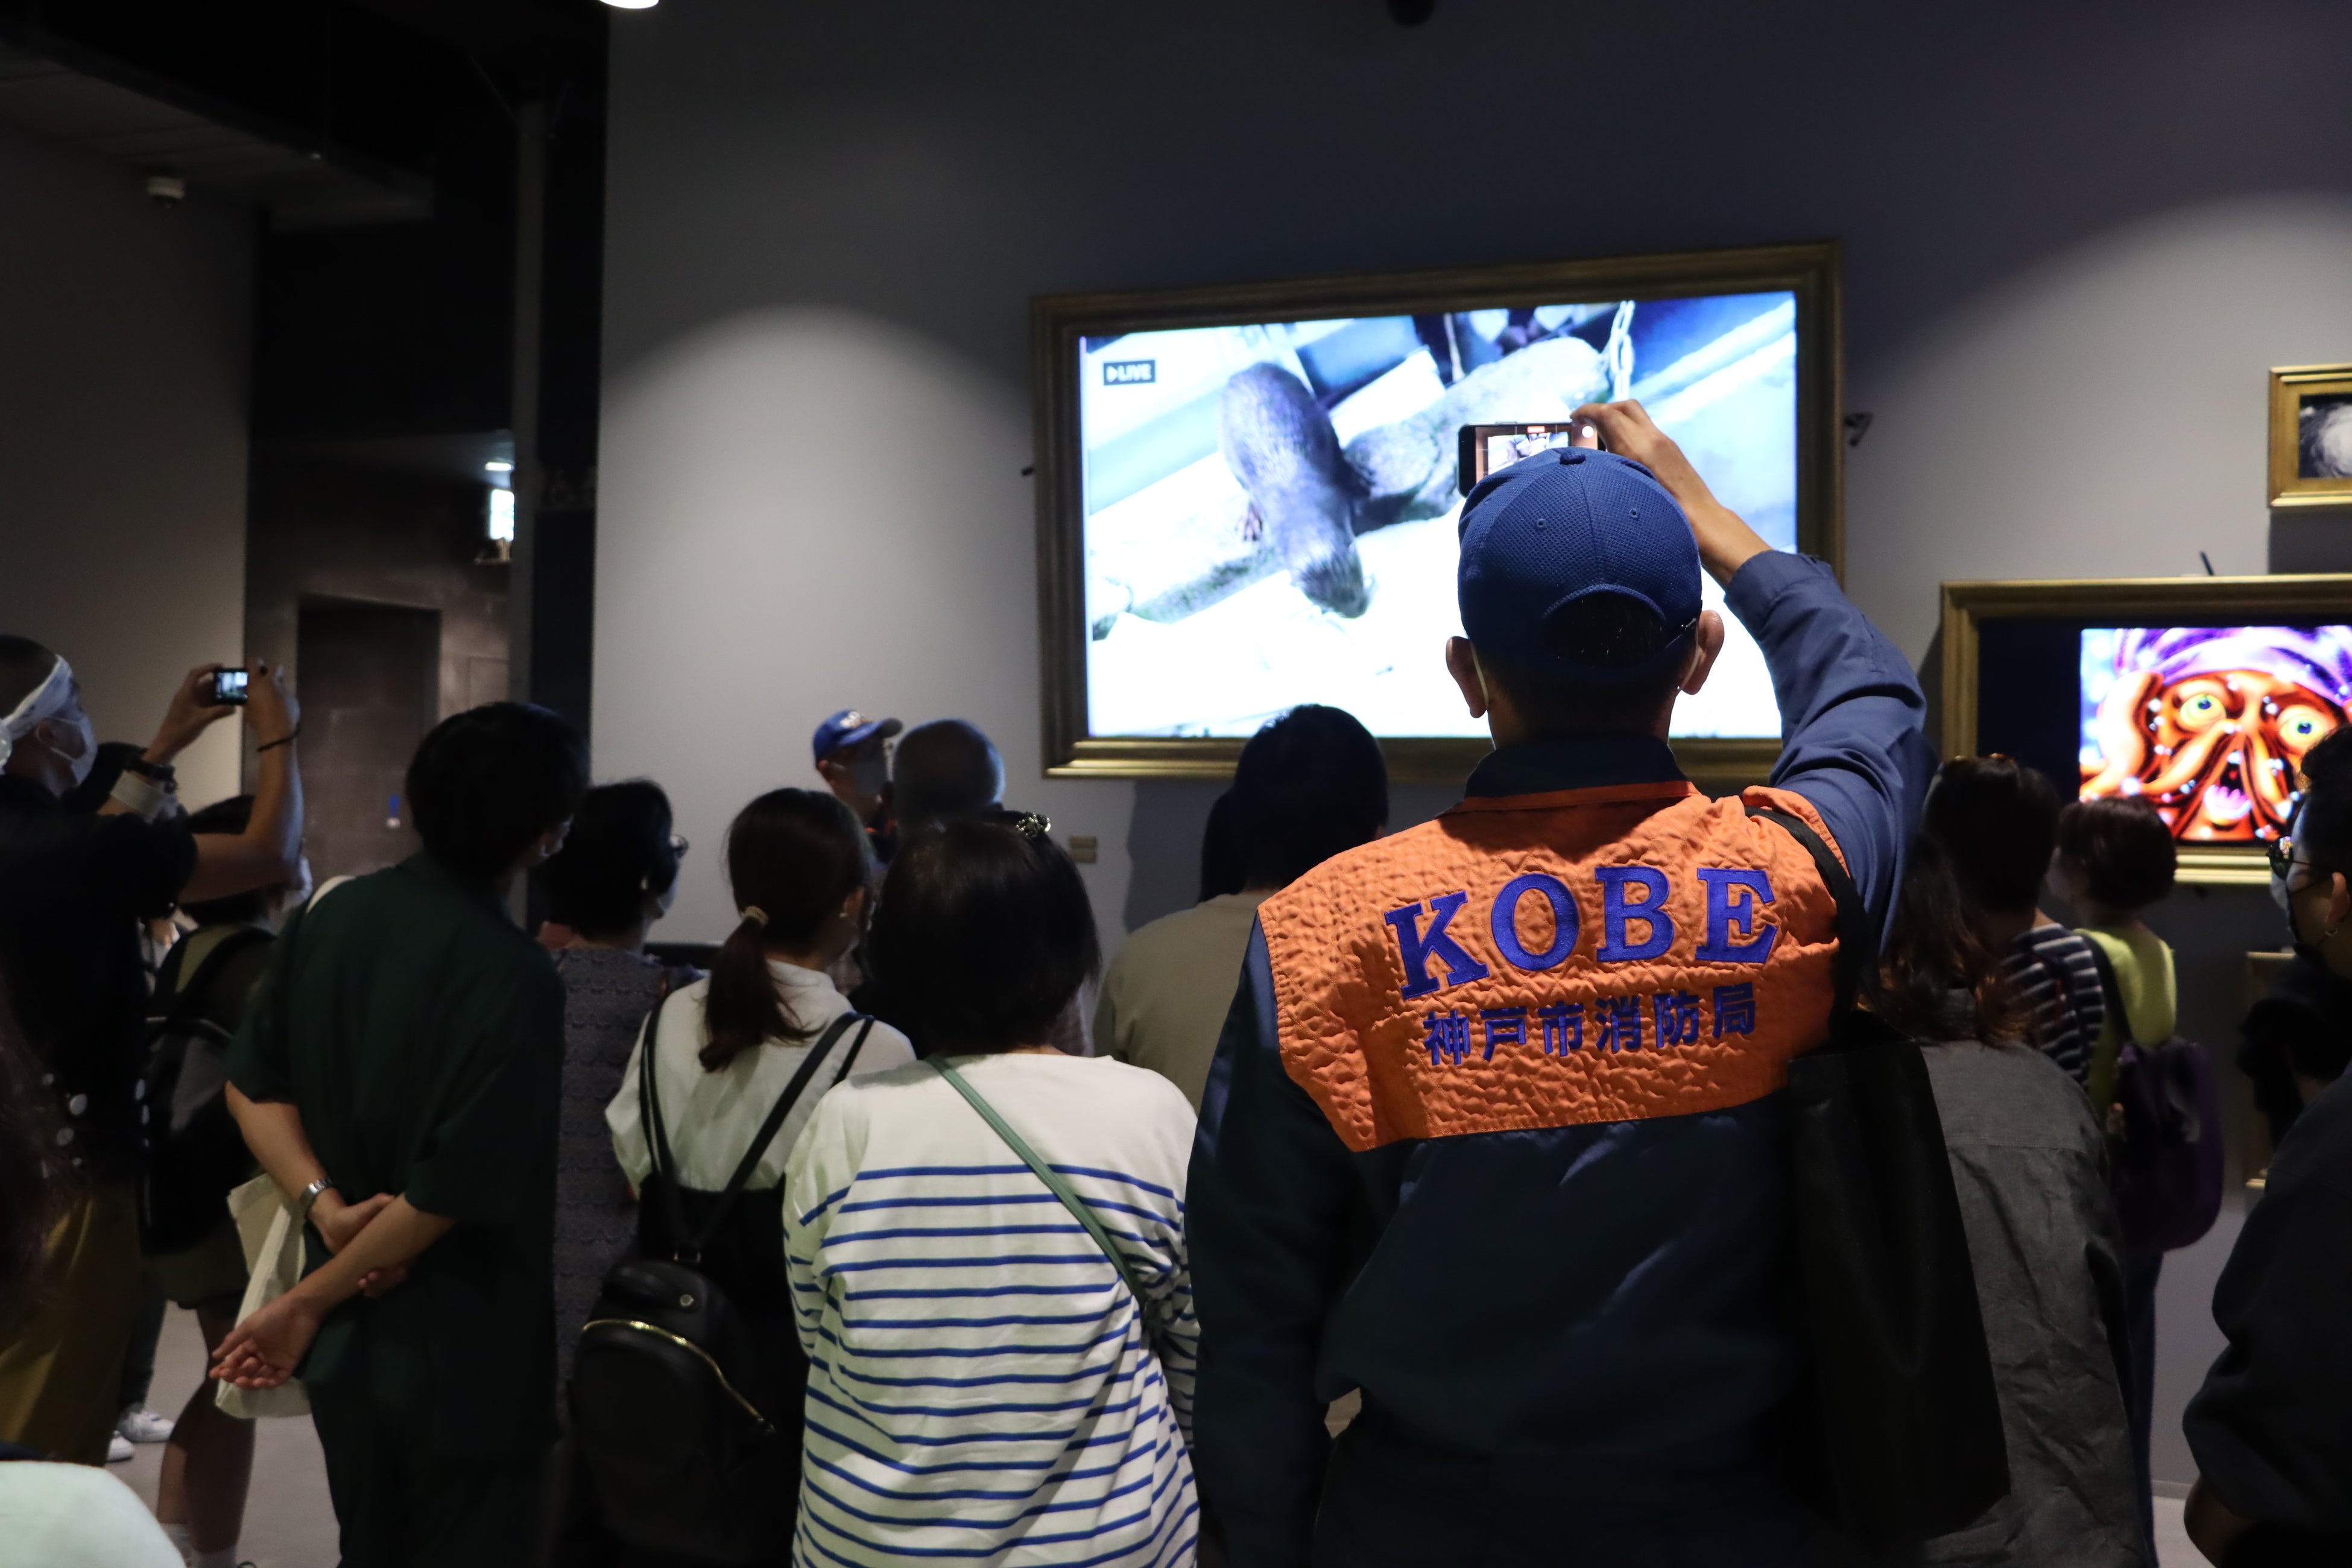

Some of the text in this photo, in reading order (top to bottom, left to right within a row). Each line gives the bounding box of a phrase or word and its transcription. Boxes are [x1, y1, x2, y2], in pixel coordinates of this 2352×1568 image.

[1118, 364, 1152, 382] LIVE
[1384, 866, 1778, 1000] KOBE
[1423, 982, 1756, 1066] 神戸市消防局
